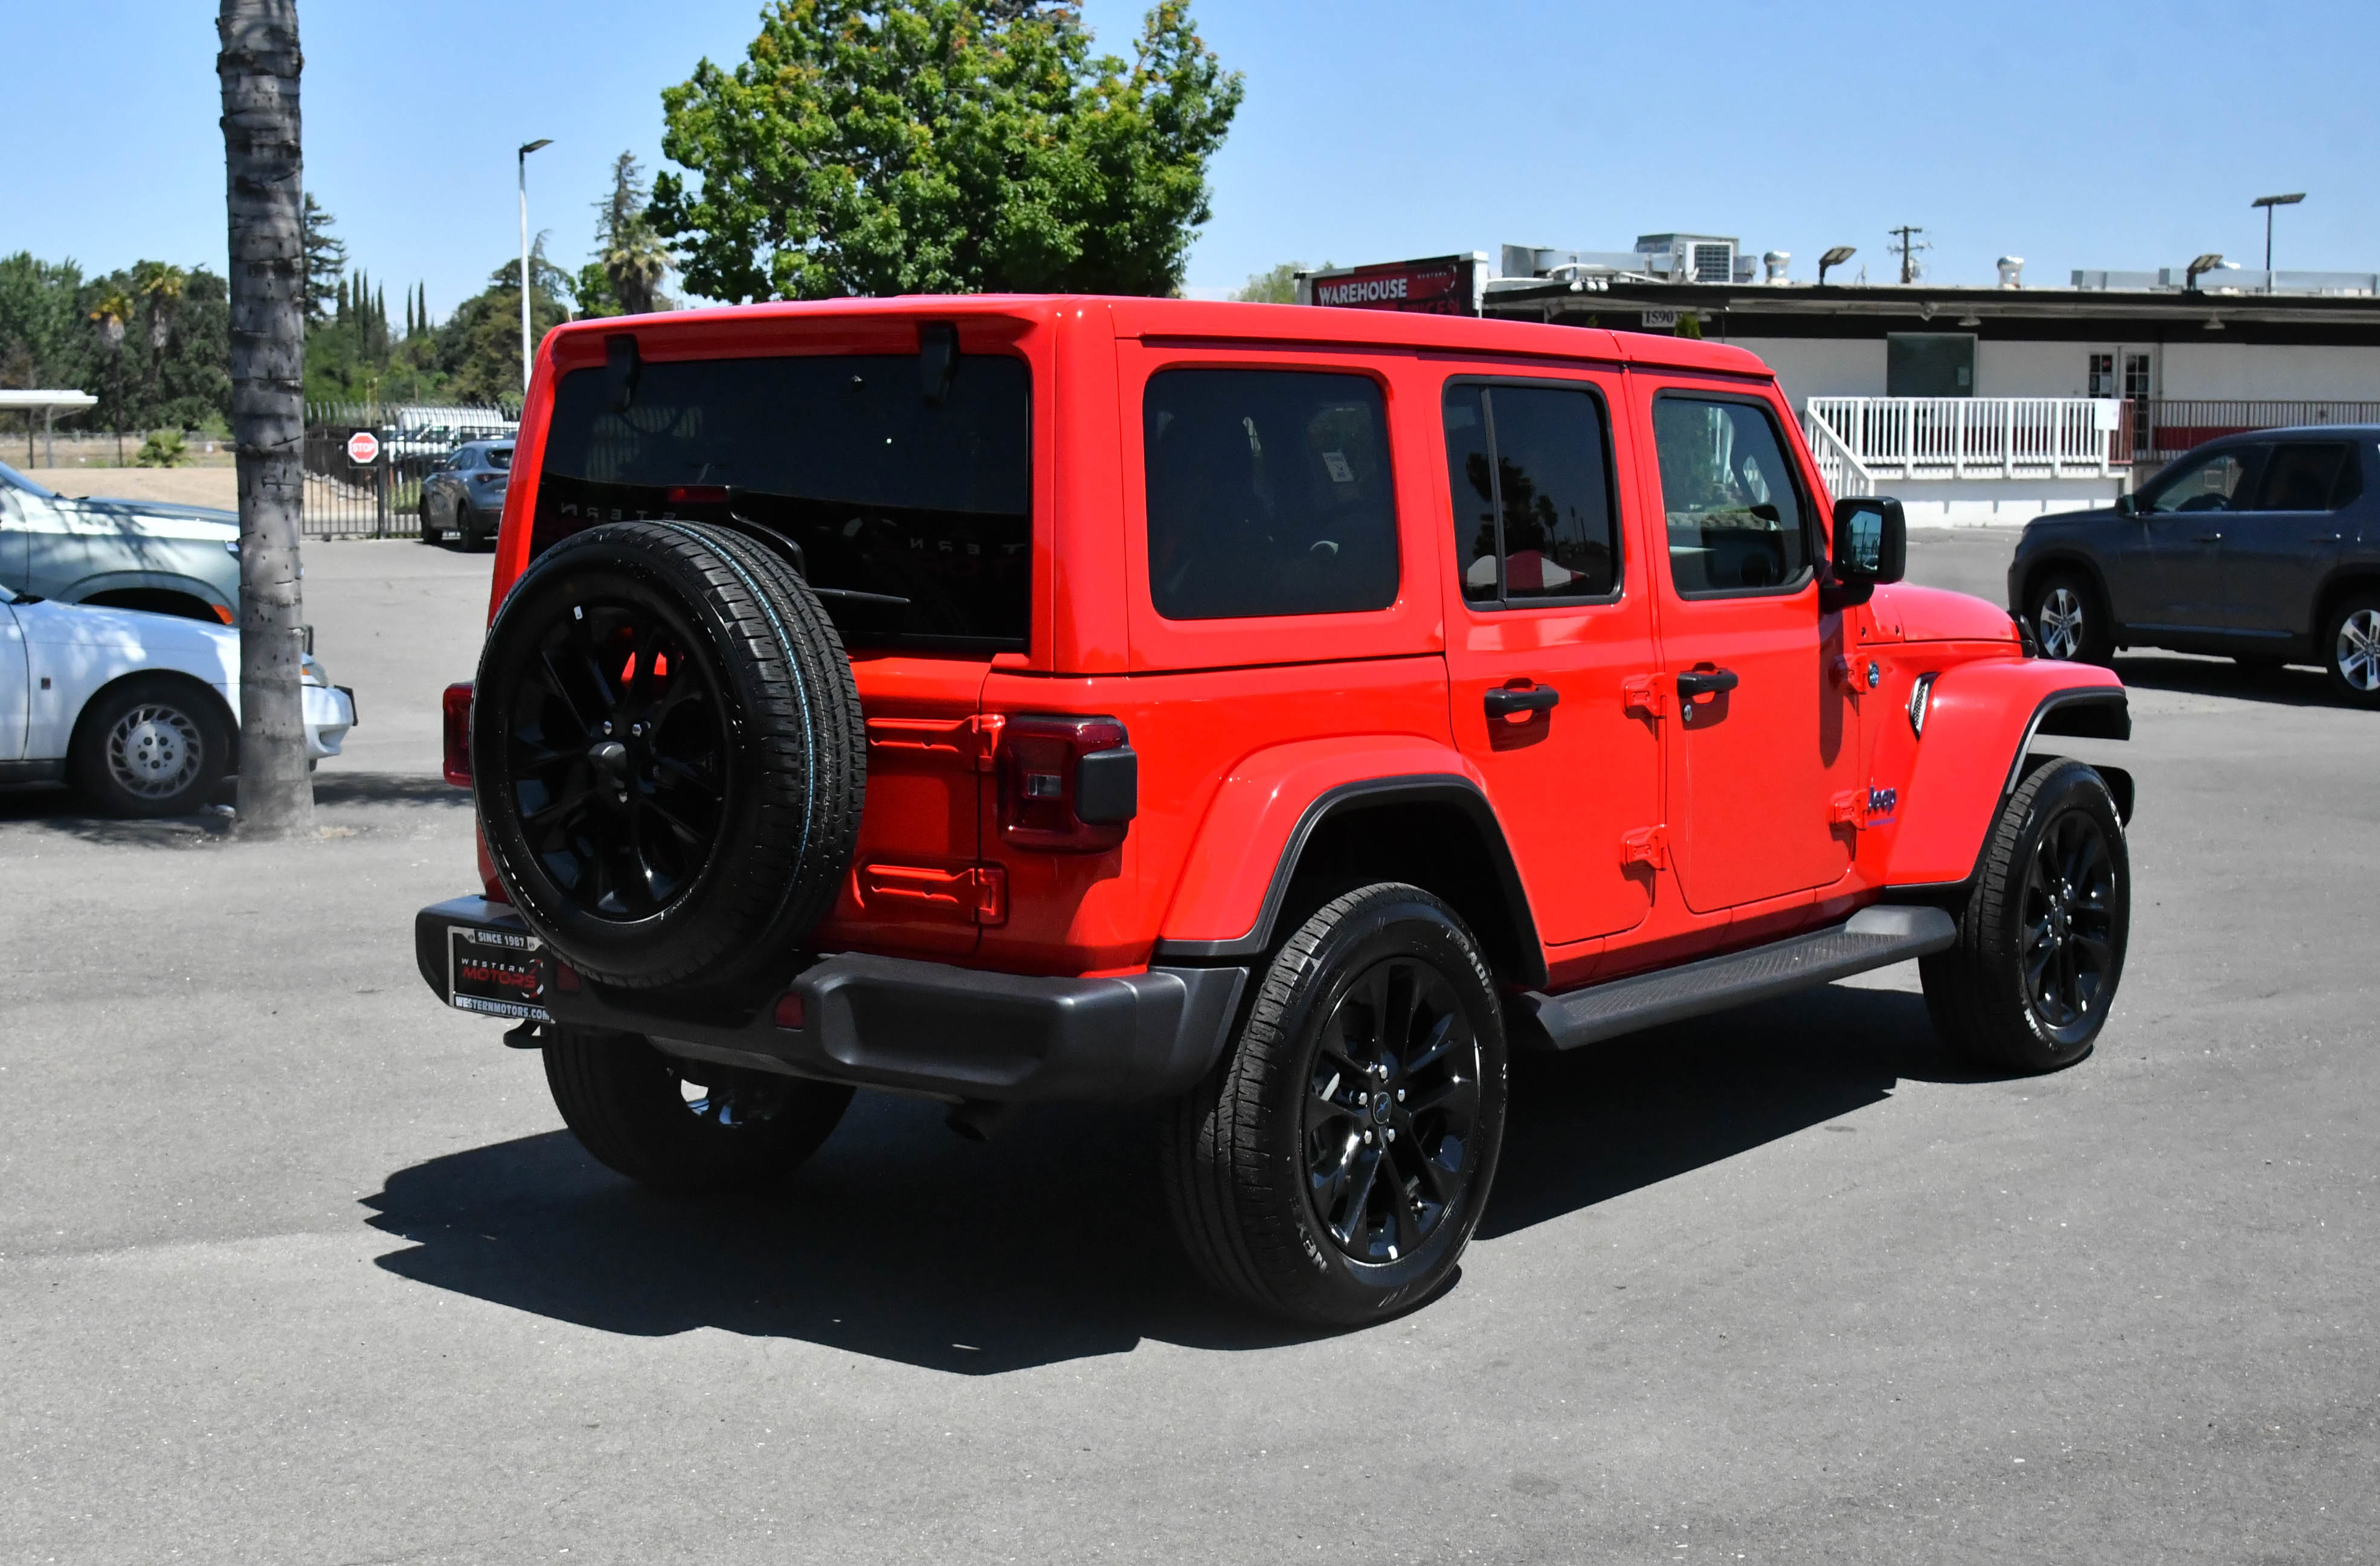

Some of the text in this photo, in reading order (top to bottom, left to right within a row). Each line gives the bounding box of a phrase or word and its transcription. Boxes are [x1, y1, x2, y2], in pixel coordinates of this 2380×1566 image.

[1319, 279, 1407, 306] WAREHOUSE
[352, 443, 376, 453] STOP
[478, 932, 524, 947] SINCE 1987
[462, 958, 525, 973] WESTERN
[463, 967, 536, 988] MOTORS
[455, 996, 550, 1020] WESTERNMOTORS.COM
